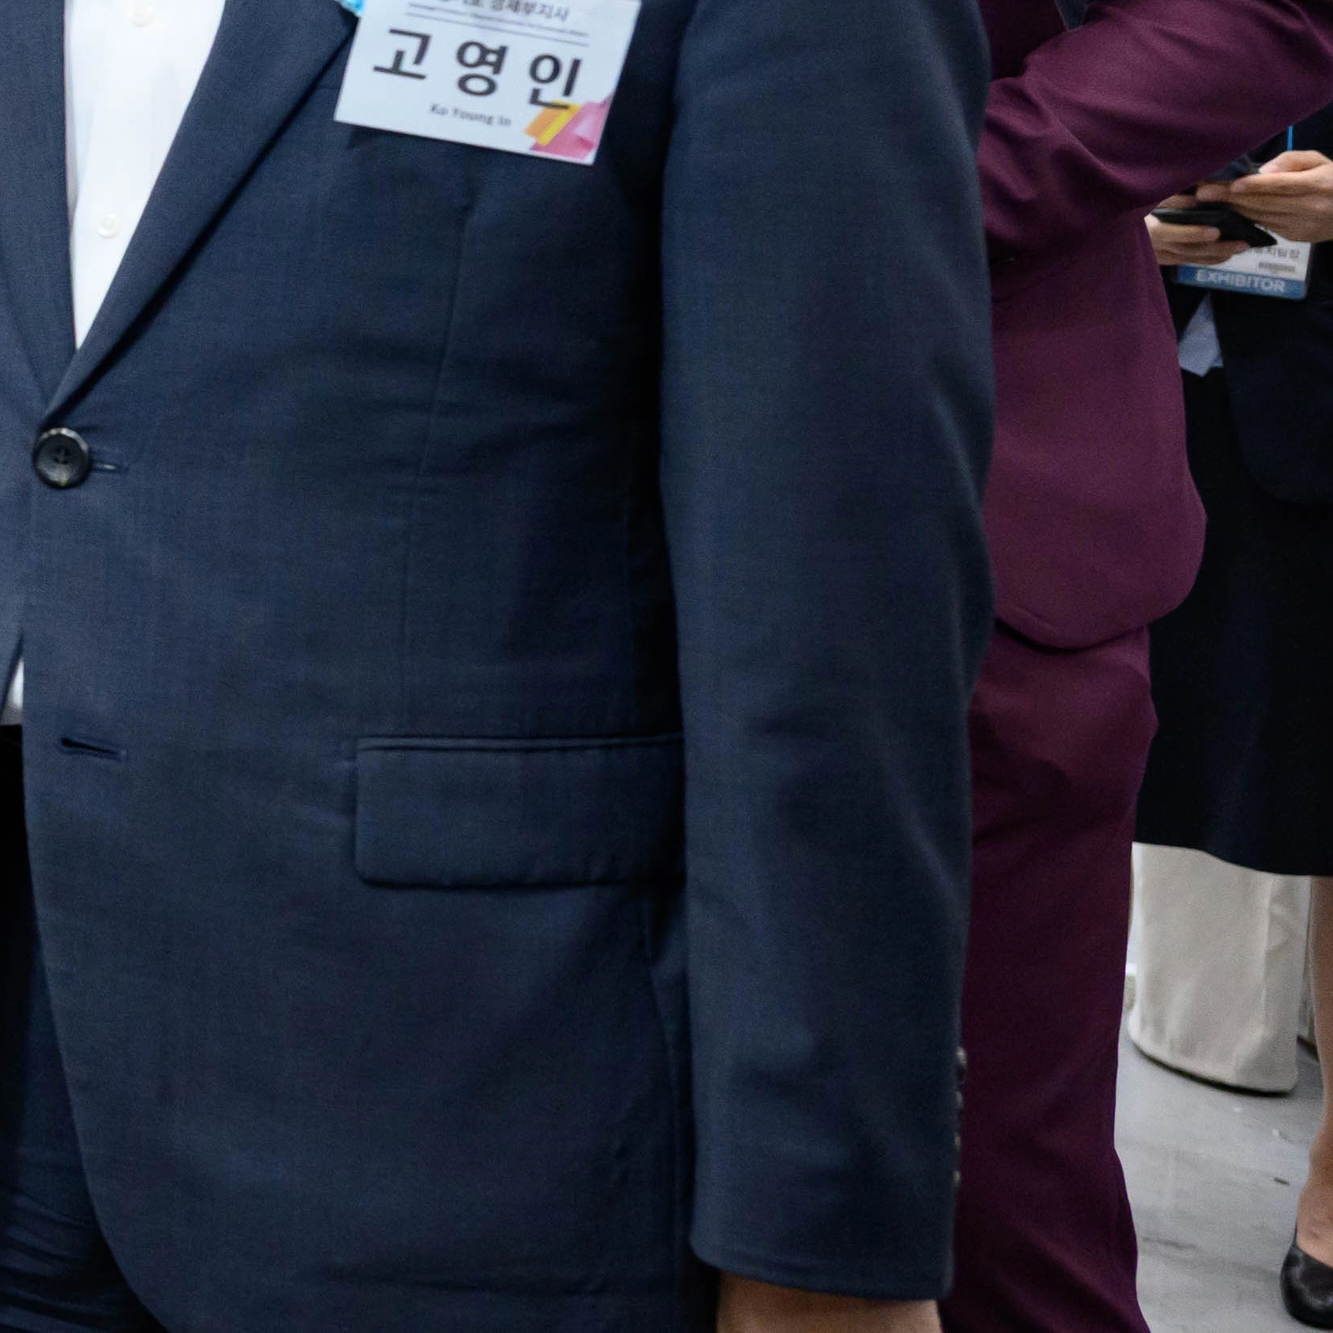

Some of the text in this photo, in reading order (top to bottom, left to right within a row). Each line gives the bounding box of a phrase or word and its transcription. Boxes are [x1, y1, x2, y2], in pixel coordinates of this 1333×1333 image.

[373, 28, 583, 110] 고영인
[452, 107, 493, 126] Young
[1194, 269, 1287, 293] EXHIBITOR
